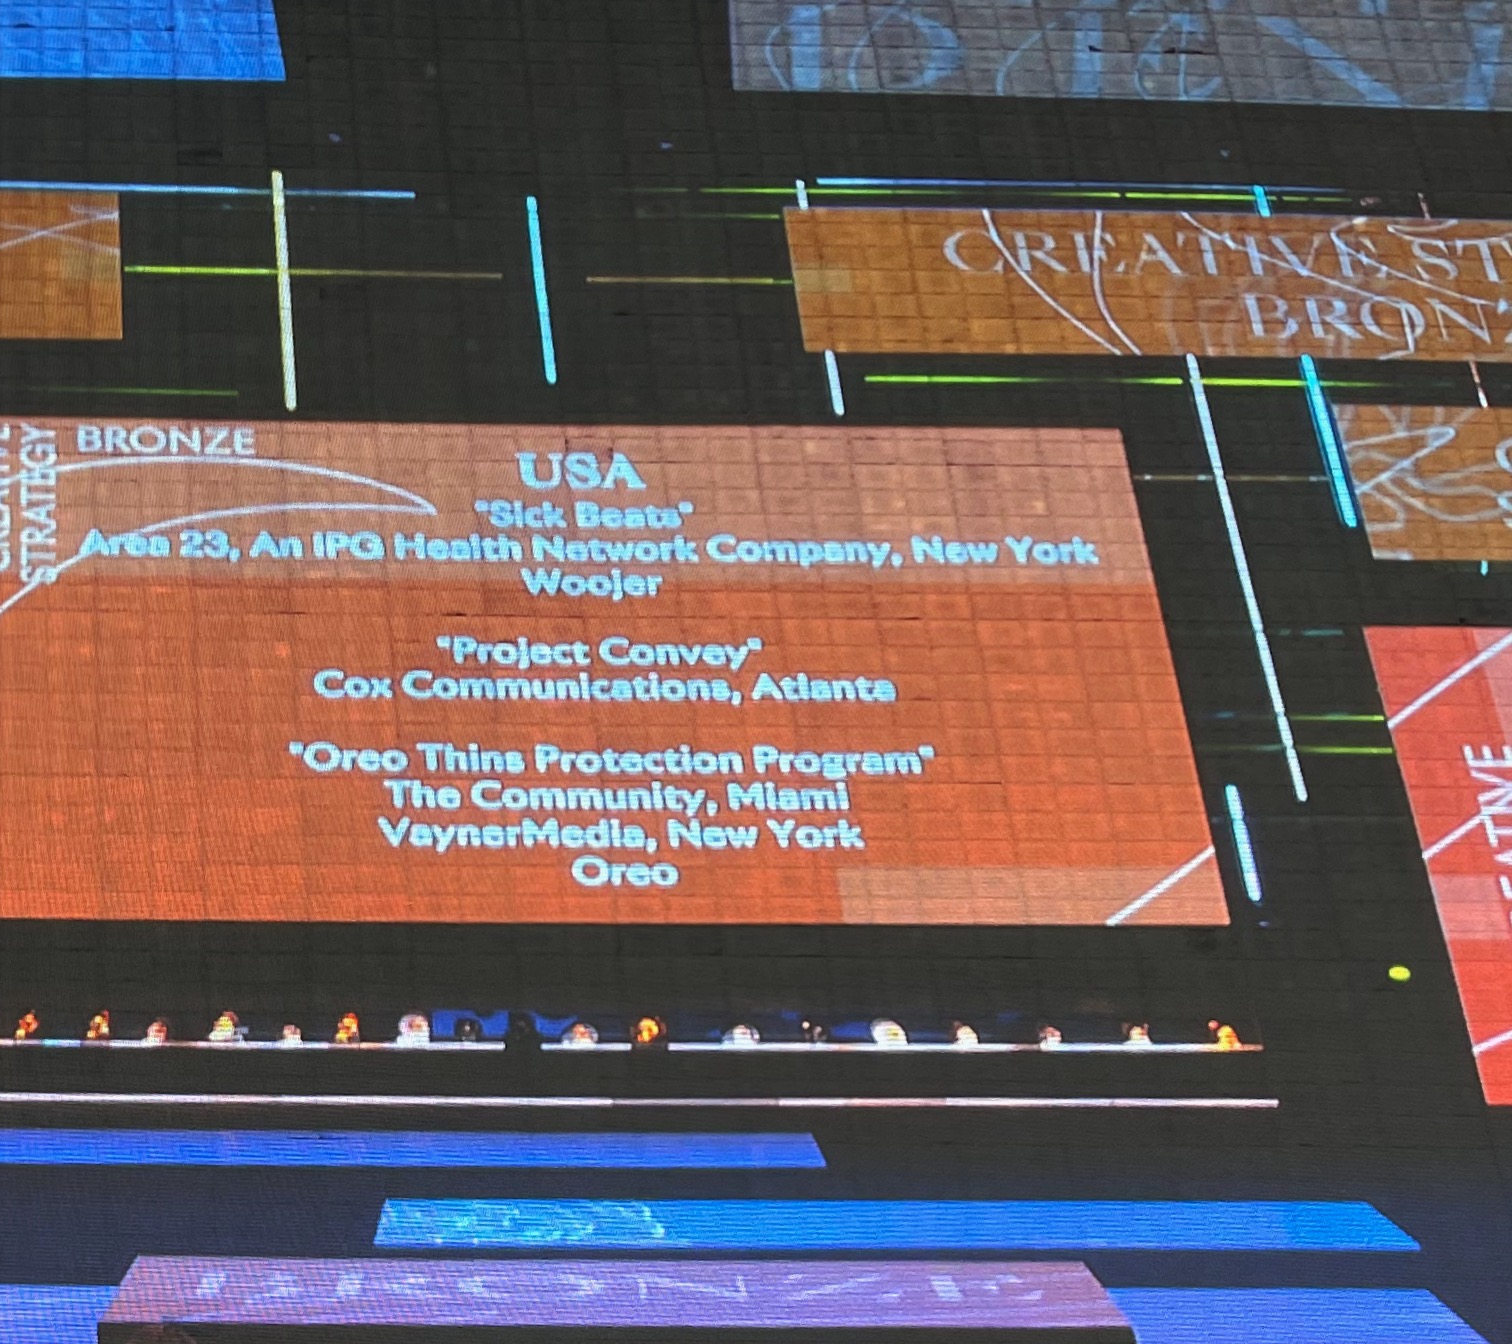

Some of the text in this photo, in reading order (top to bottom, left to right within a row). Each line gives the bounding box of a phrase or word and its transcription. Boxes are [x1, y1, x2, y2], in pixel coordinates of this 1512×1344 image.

[1243, 293, 1512, 344] BRON
[76, 425, 256, 456] BRONZE
[515, 452, 647, 490] USA
[20, 422, 58, 584] STRATEGY
[474, 500, 694, 529] "Sick Beats"
[81, 528, 1100, 568] Area 23, An IPG Health Network Company, New York
[522, 567, 662, 601] Woojer
[436, 635, 763, 672] "Project Convey"
[313, 668, 897, 706] Cox Communications, Atlanta
[289, 741, 934, 781] "Oreo Thins Protection Program"
[384, 778, 850, 817] The Community, Miami
[377, 815, 865, 853] VaynerMedia, New York
[570, 854, 679, 888] Oreo
